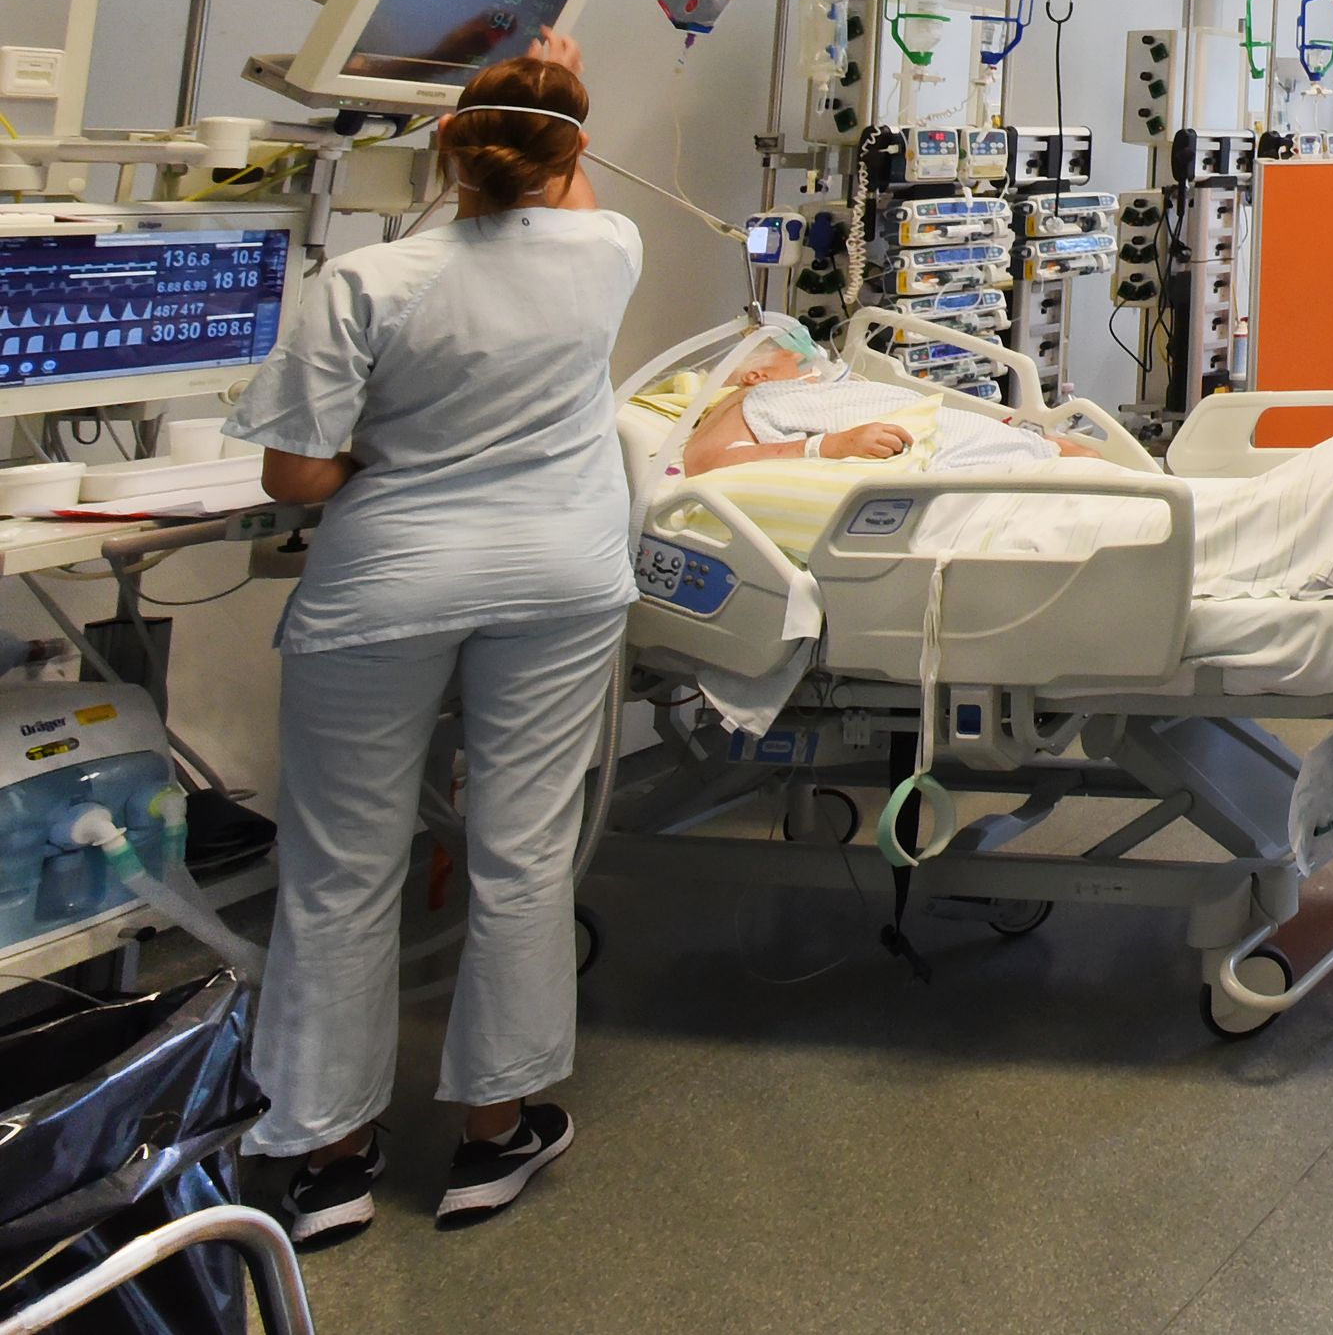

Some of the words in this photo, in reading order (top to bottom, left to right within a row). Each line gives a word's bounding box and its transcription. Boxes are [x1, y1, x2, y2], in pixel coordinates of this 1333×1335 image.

[163, 249, 185, 268] 13
[187, 251, 210, 267] 6.8
[231, 249, 262, 265] 10.5
[213, 271, 234, 289] 18
[238, 270, 258, 287] 18
[153, 304, 178, 317] 487
[180, 302, 205, 315] 417
[150, 324, 175, 343] 30
[177, 321, 201, 340] 30
[207, 321, 228, 338] 69
[229, 320, 252, 336] 8.6
[20, 716, 66, 737] Dräger
